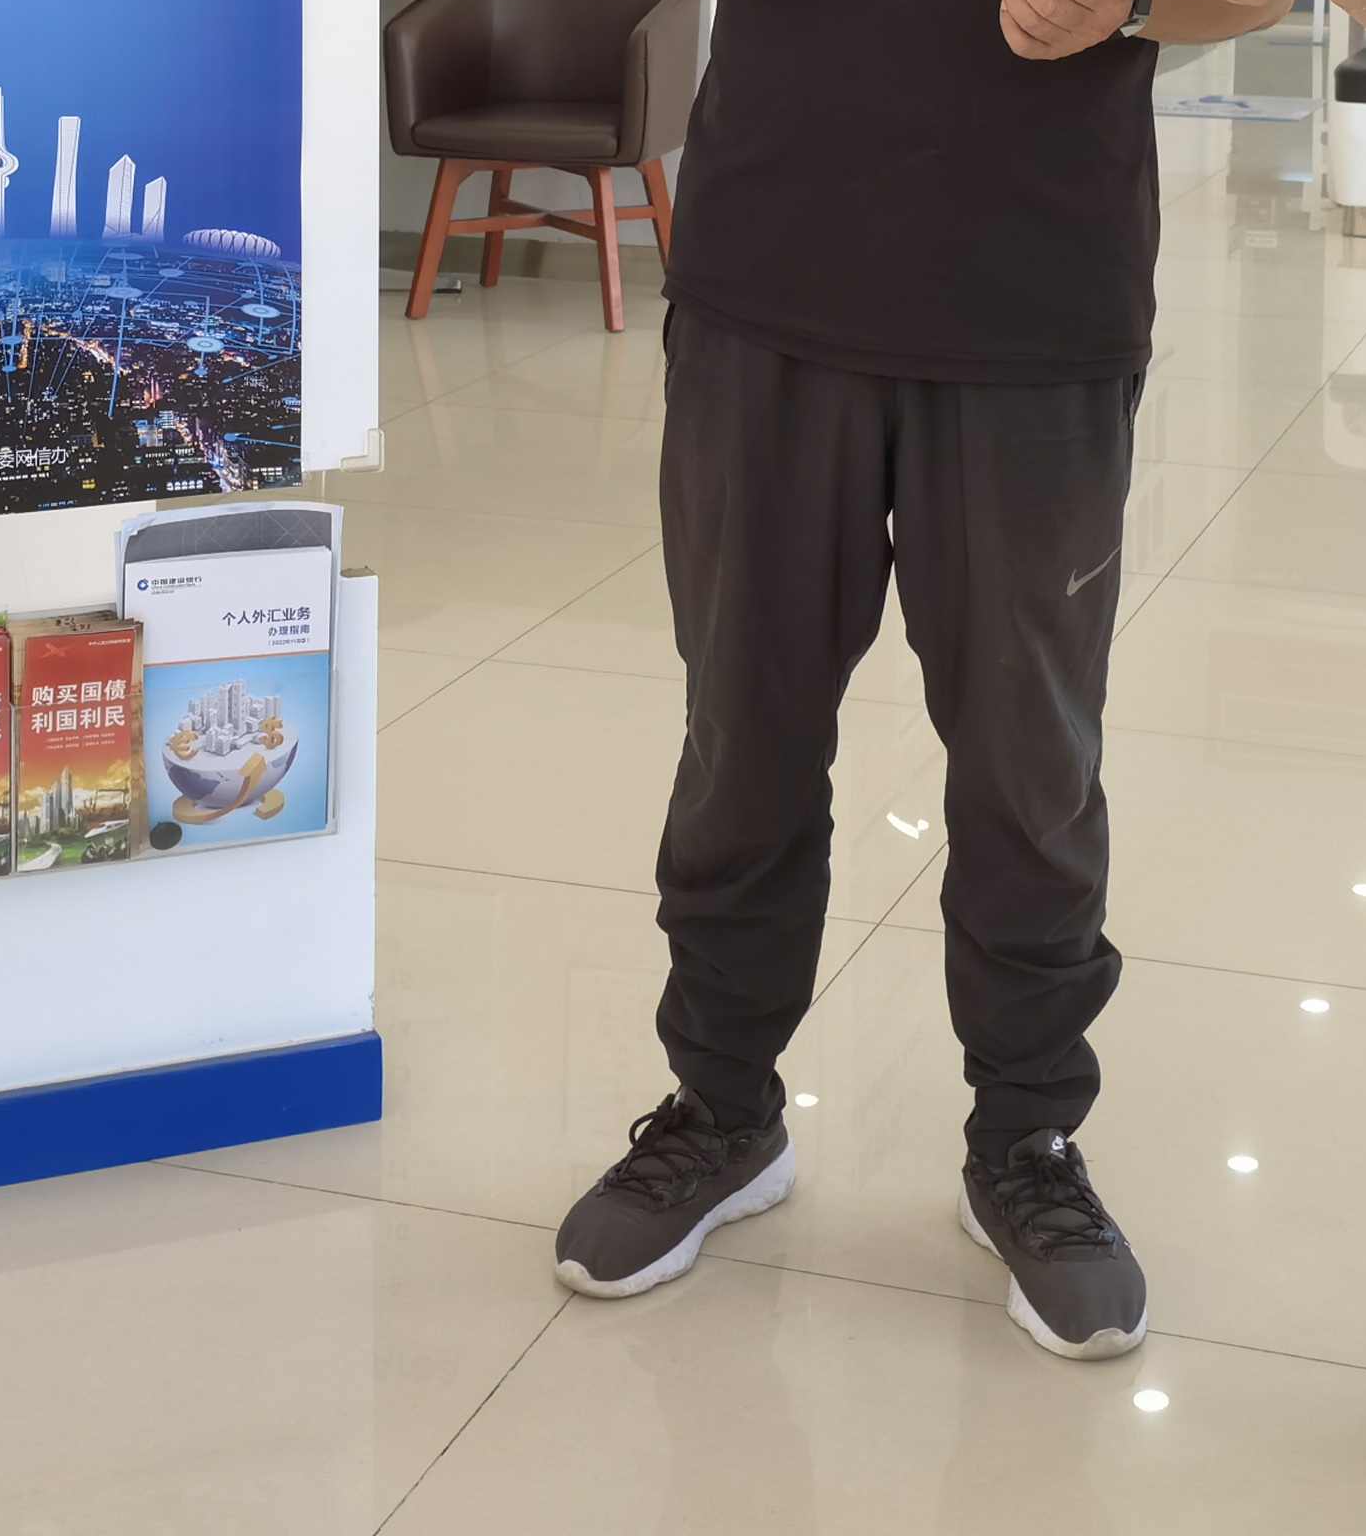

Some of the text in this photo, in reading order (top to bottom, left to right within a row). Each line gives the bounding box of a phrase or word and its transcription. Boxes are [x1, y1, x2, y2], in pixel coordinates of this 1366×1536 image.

[222, 606, 311, 626] 个人外汇业务
[268, 624, 310, 637] 办理指南
[31, 679, 126, 707] 购买国债
[31, 705, 125, 734] 利国利民
